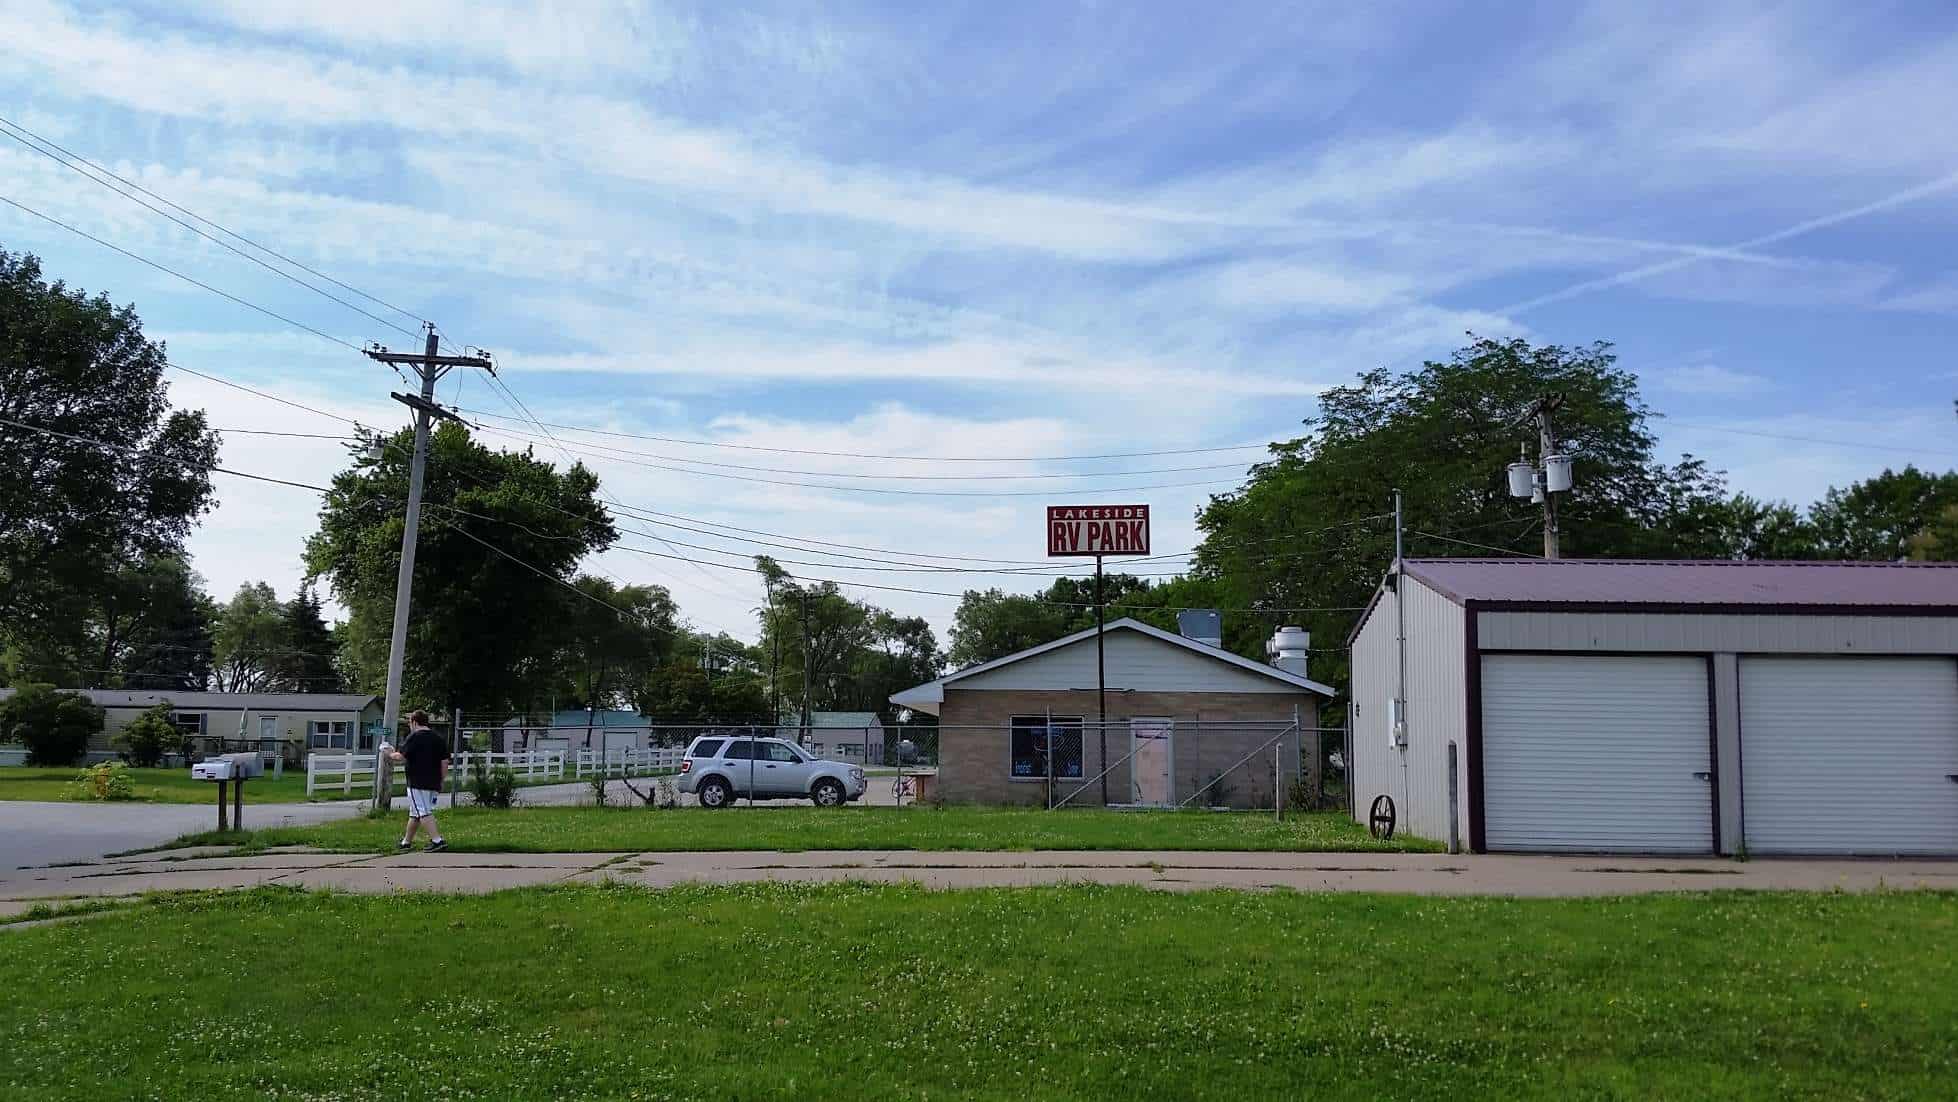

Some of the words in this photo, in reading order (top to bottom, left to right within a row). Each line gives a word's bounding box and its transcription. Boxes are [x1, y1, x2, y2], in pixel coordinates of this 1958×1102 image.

[1052, 508, 1145, 519] LAKESIDE
[1053, 521, 1081, 552] RV
[1087, 520, 1144, 551] PARK
